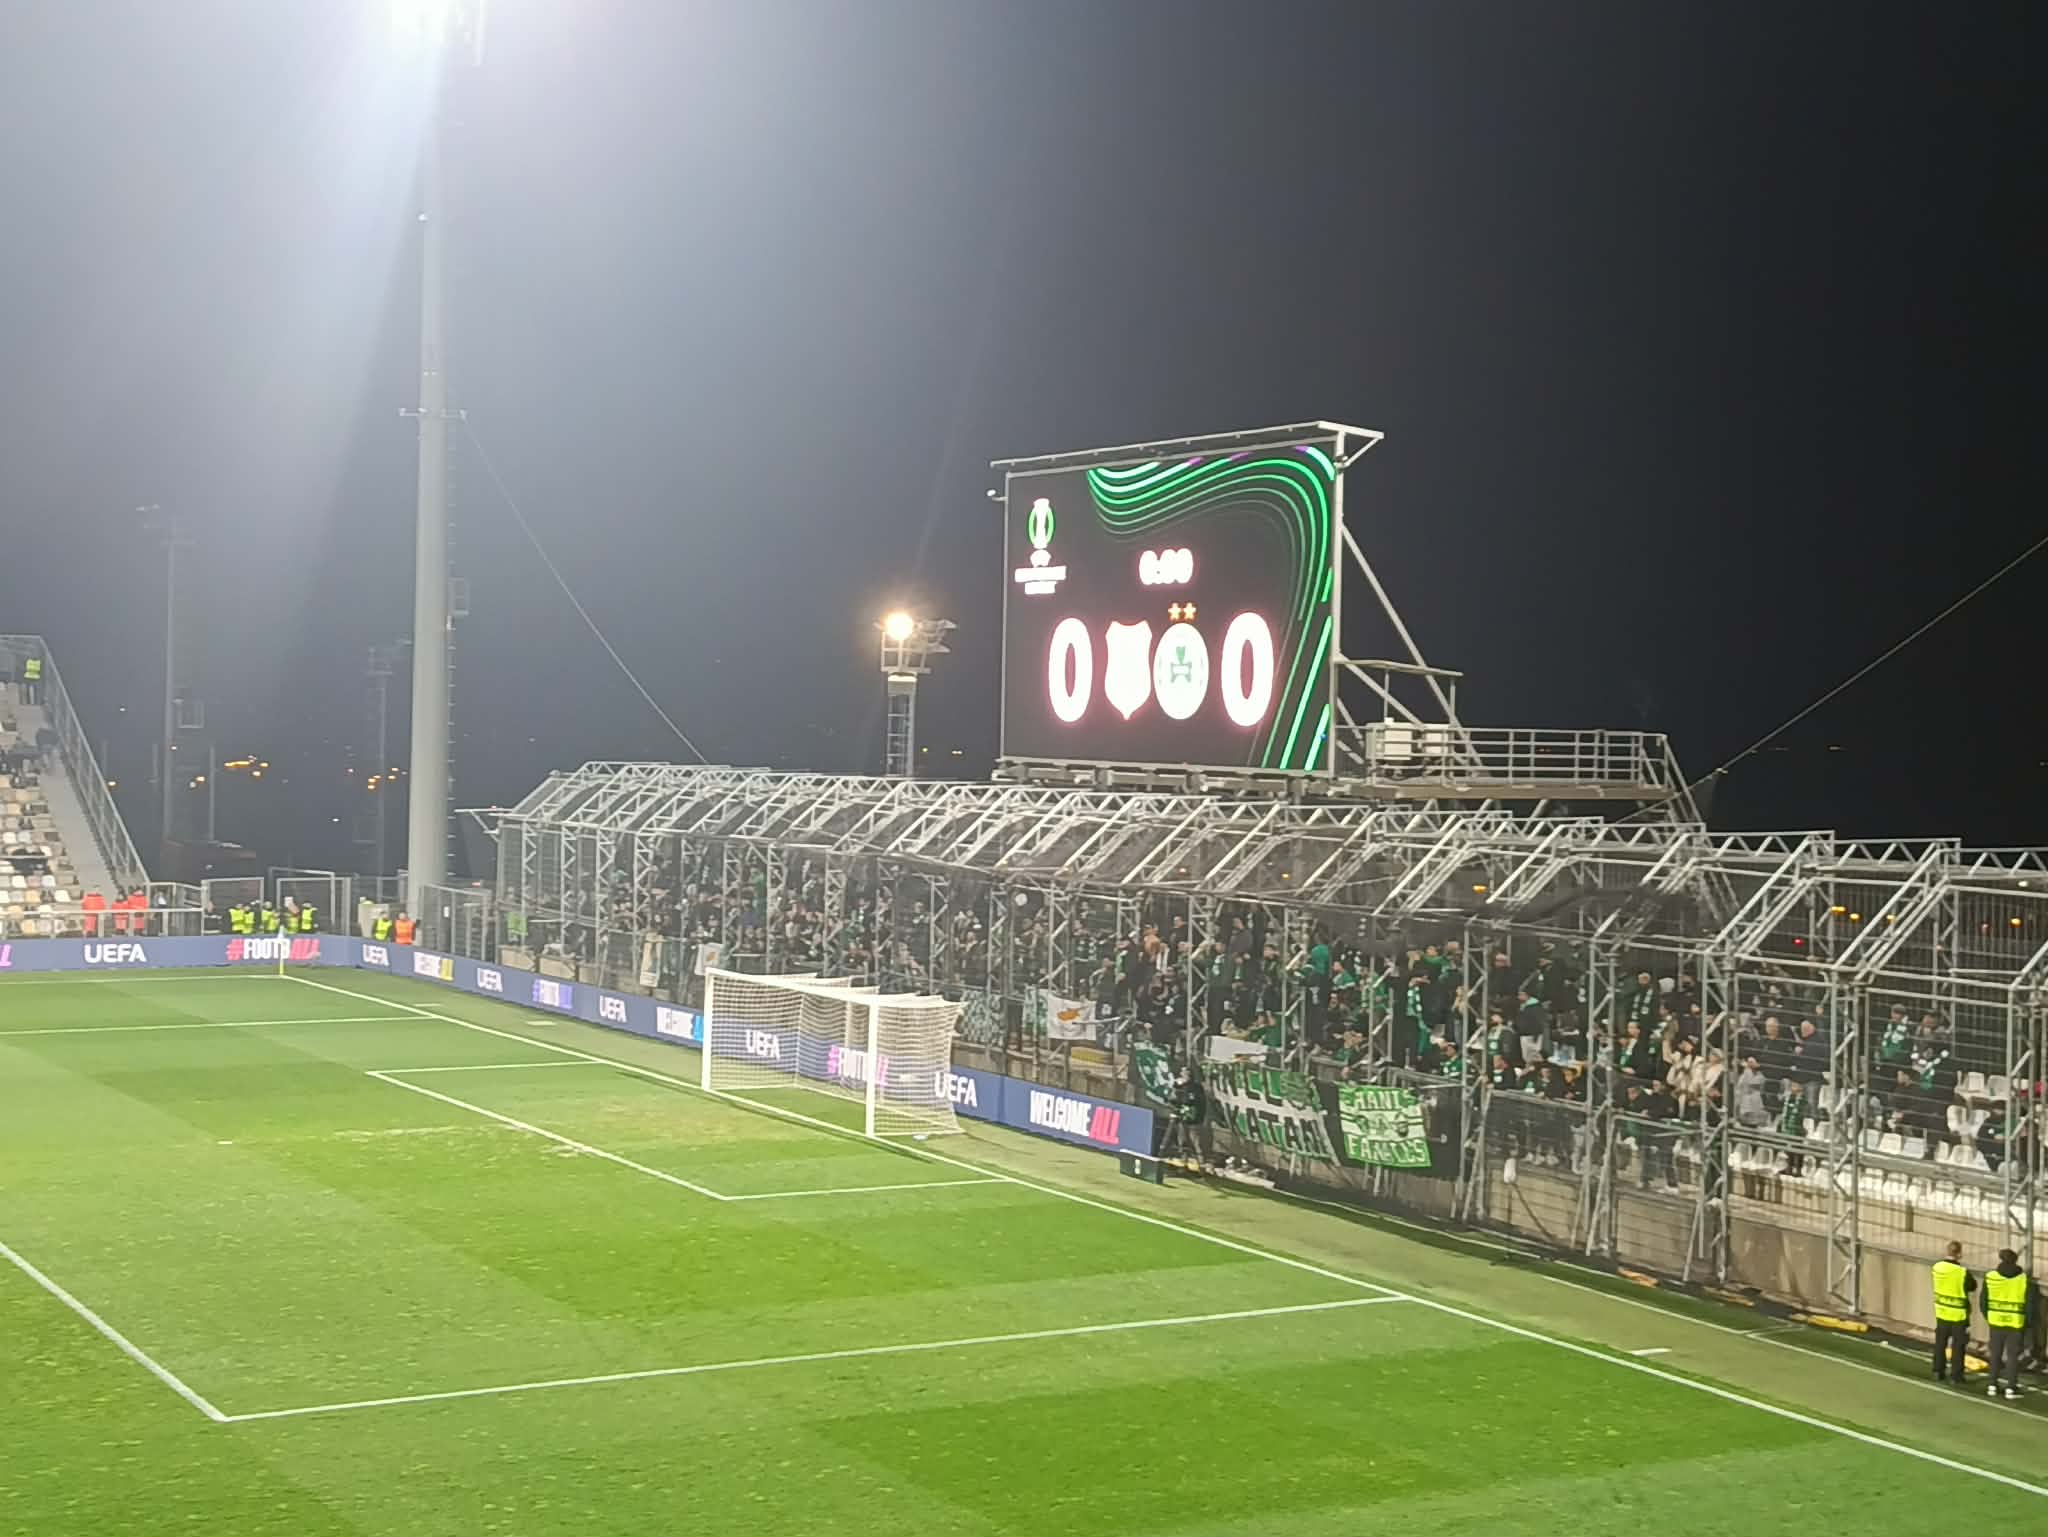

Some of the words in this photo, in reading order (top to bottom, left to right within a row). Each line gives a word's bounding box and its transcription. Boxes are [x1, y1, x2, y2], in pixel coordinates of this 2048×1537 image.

[1048, 617, 1093, 722] 0
[1221, 612, 1274, 727] 0
[84, 943, 147, 963] UEFA
[362, 943, 390, 967] UEFA
[477, 967, 504, 993] UEFA
[599, 994, 628, 1023] UEFA
[745, 1028, 781, 1060] UEFA
[934, 1070, 978, 1108] UEFA
[1029, 1089, 1092, 1138] WELCOME
[1087, 1105, 1121, 1146] ALL
